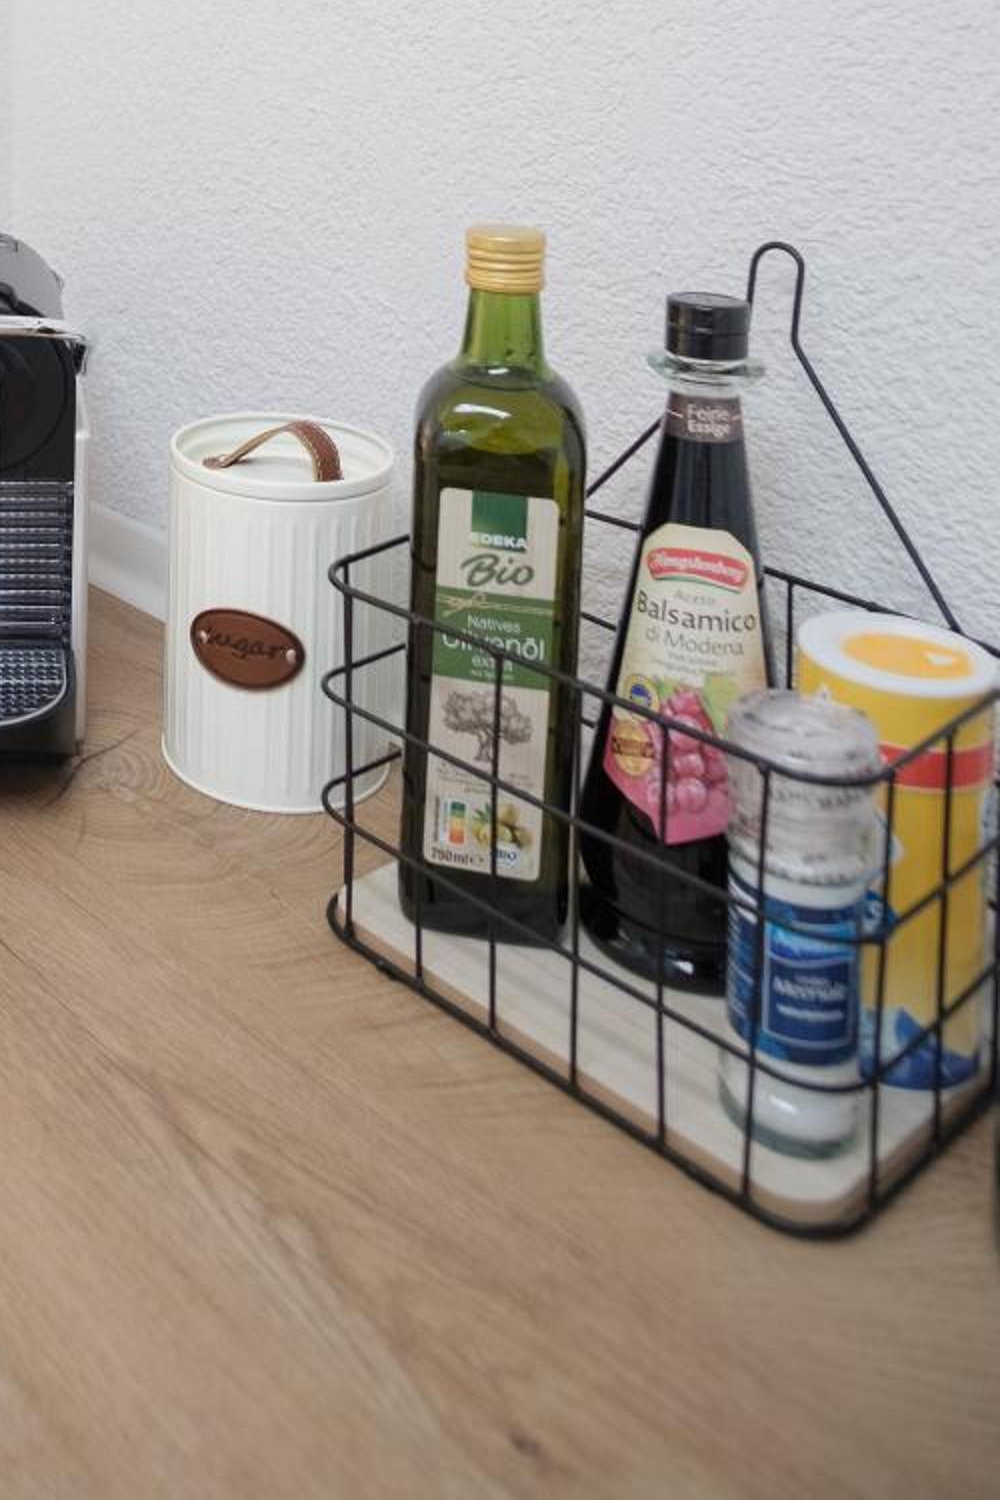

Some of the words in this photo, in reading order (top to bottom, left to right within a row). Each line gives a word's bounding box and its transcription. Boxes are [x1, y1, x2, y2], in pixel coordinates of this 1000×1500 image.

[460, 553, 535, 587] Bio
[637, 589, 756, 632] Balsamico
[663, 630, 744, 656] Modena
